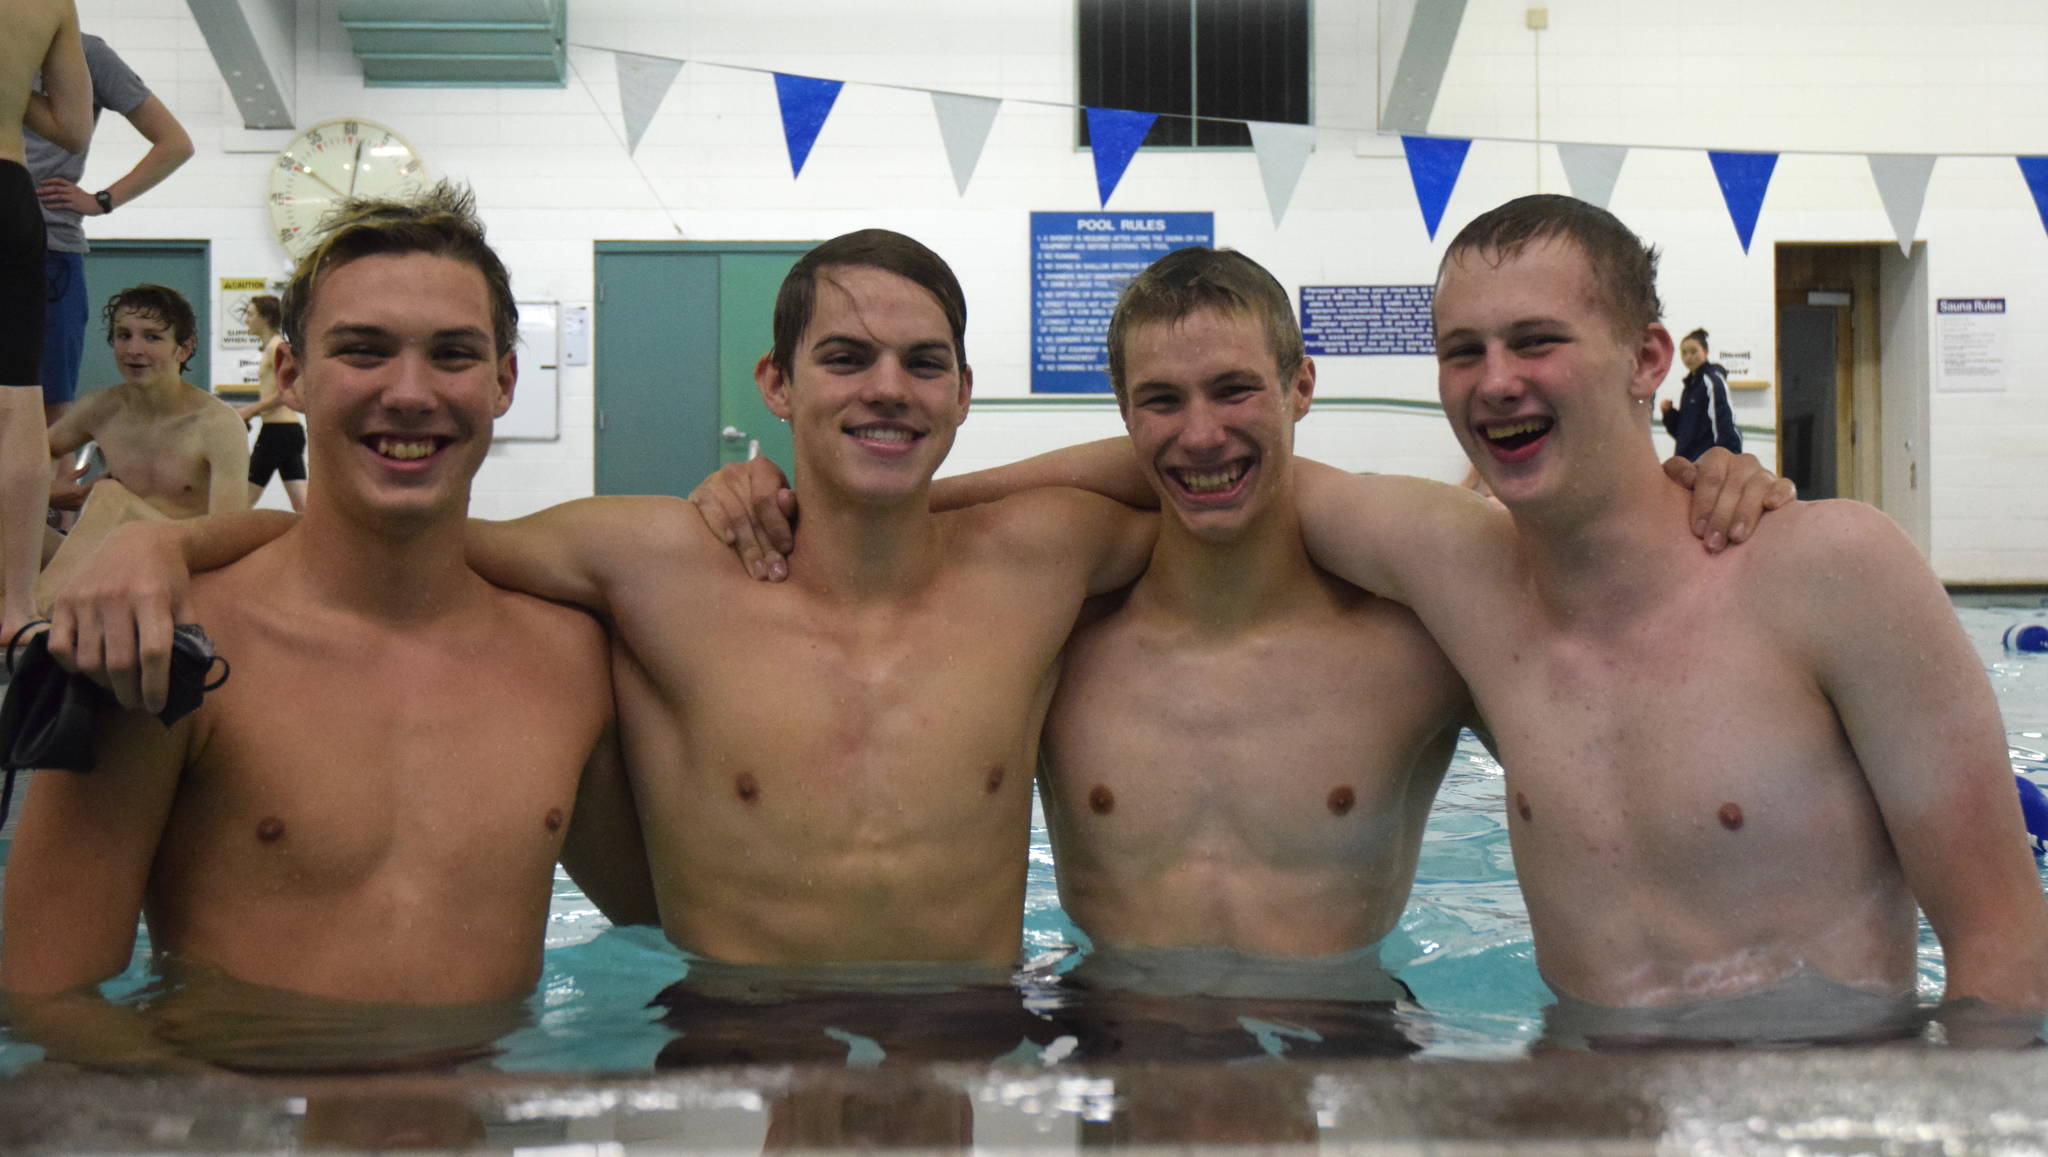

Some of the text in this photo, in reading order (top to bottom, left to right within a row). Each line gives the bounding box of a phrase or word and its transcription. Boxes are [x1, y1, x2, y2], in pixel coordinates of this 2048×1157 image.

[344, 122, 358, 135] 60
[1077, 219, 1166, 231] POOL RULES
[233, 282, 264, 290] CAUTION
[1940, 300, 2002, 312] Sauna Rules
